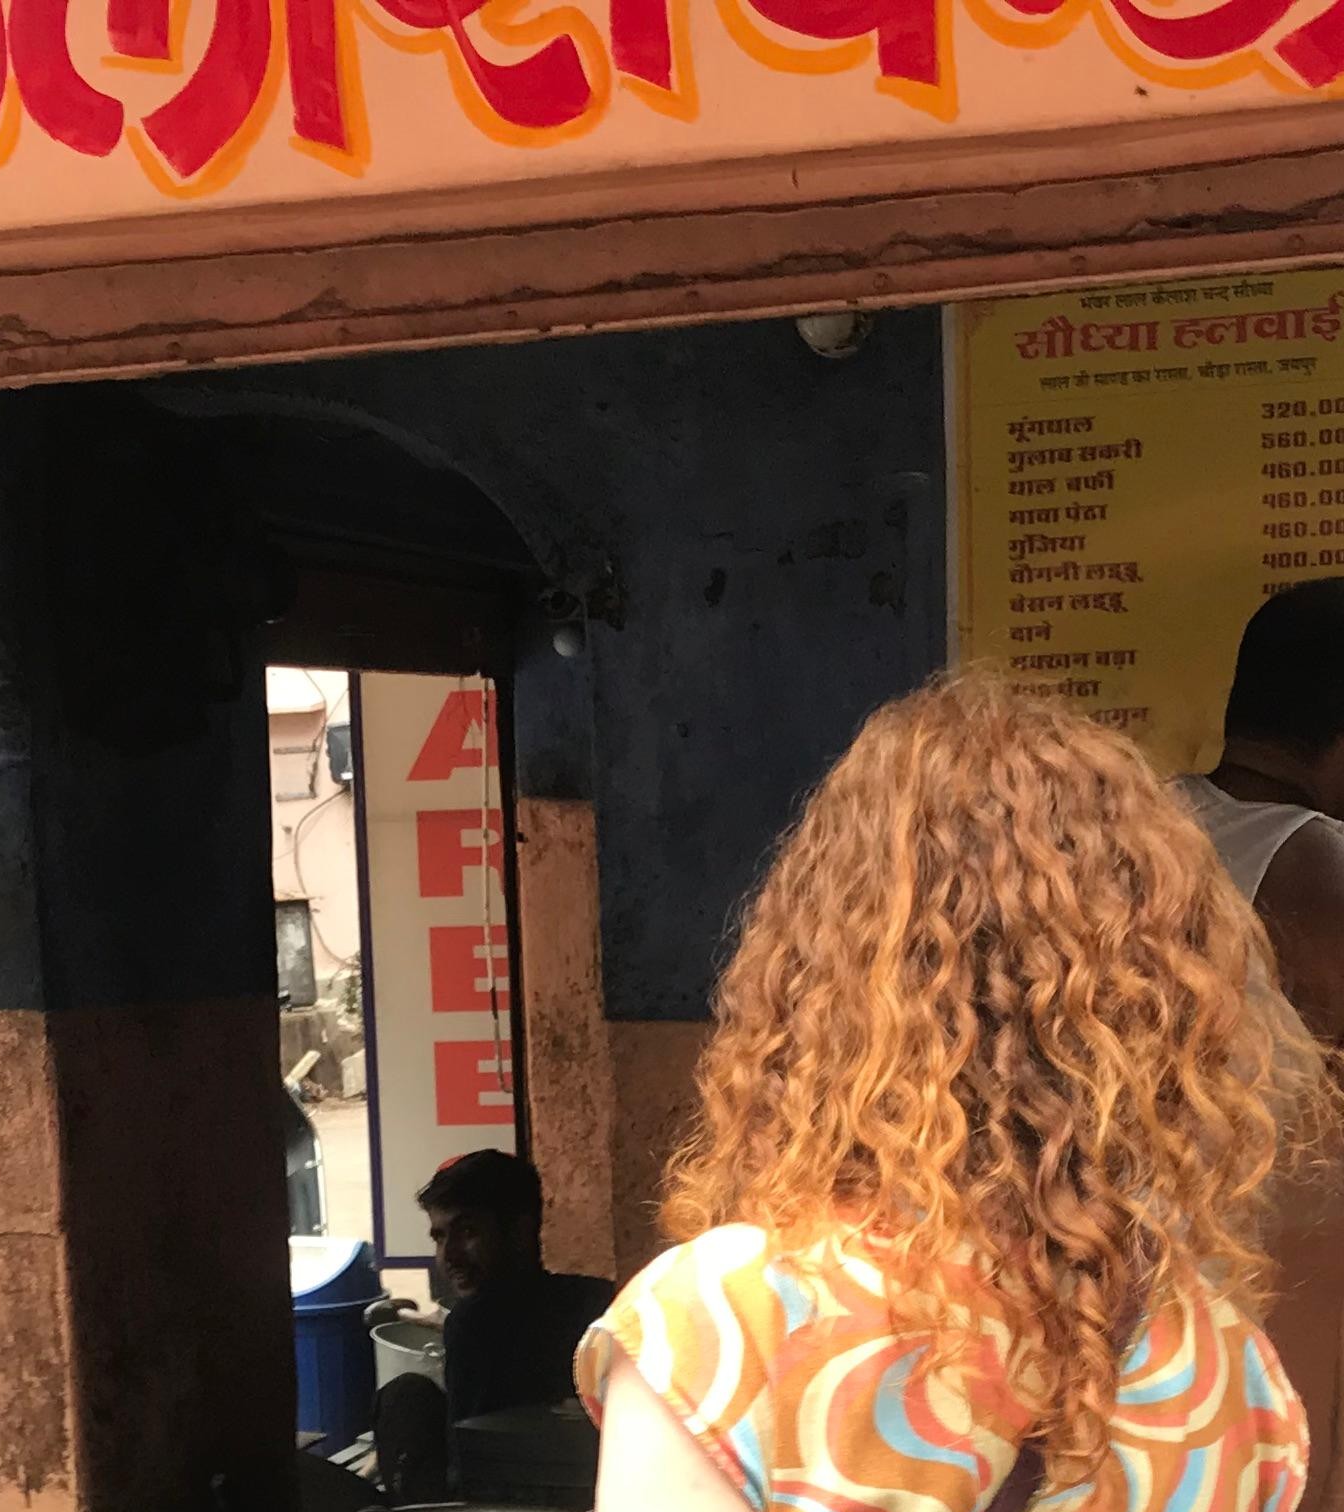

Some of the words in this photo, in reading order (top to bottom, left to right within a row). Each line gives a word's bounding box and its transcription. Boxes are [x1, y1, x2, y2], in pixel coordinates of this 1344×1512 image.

[1014, 314, 1160, 359] सौध्या
[1170, 291, 1344, 349] हलवाई
[406, 688, 518, 1172] AREE
